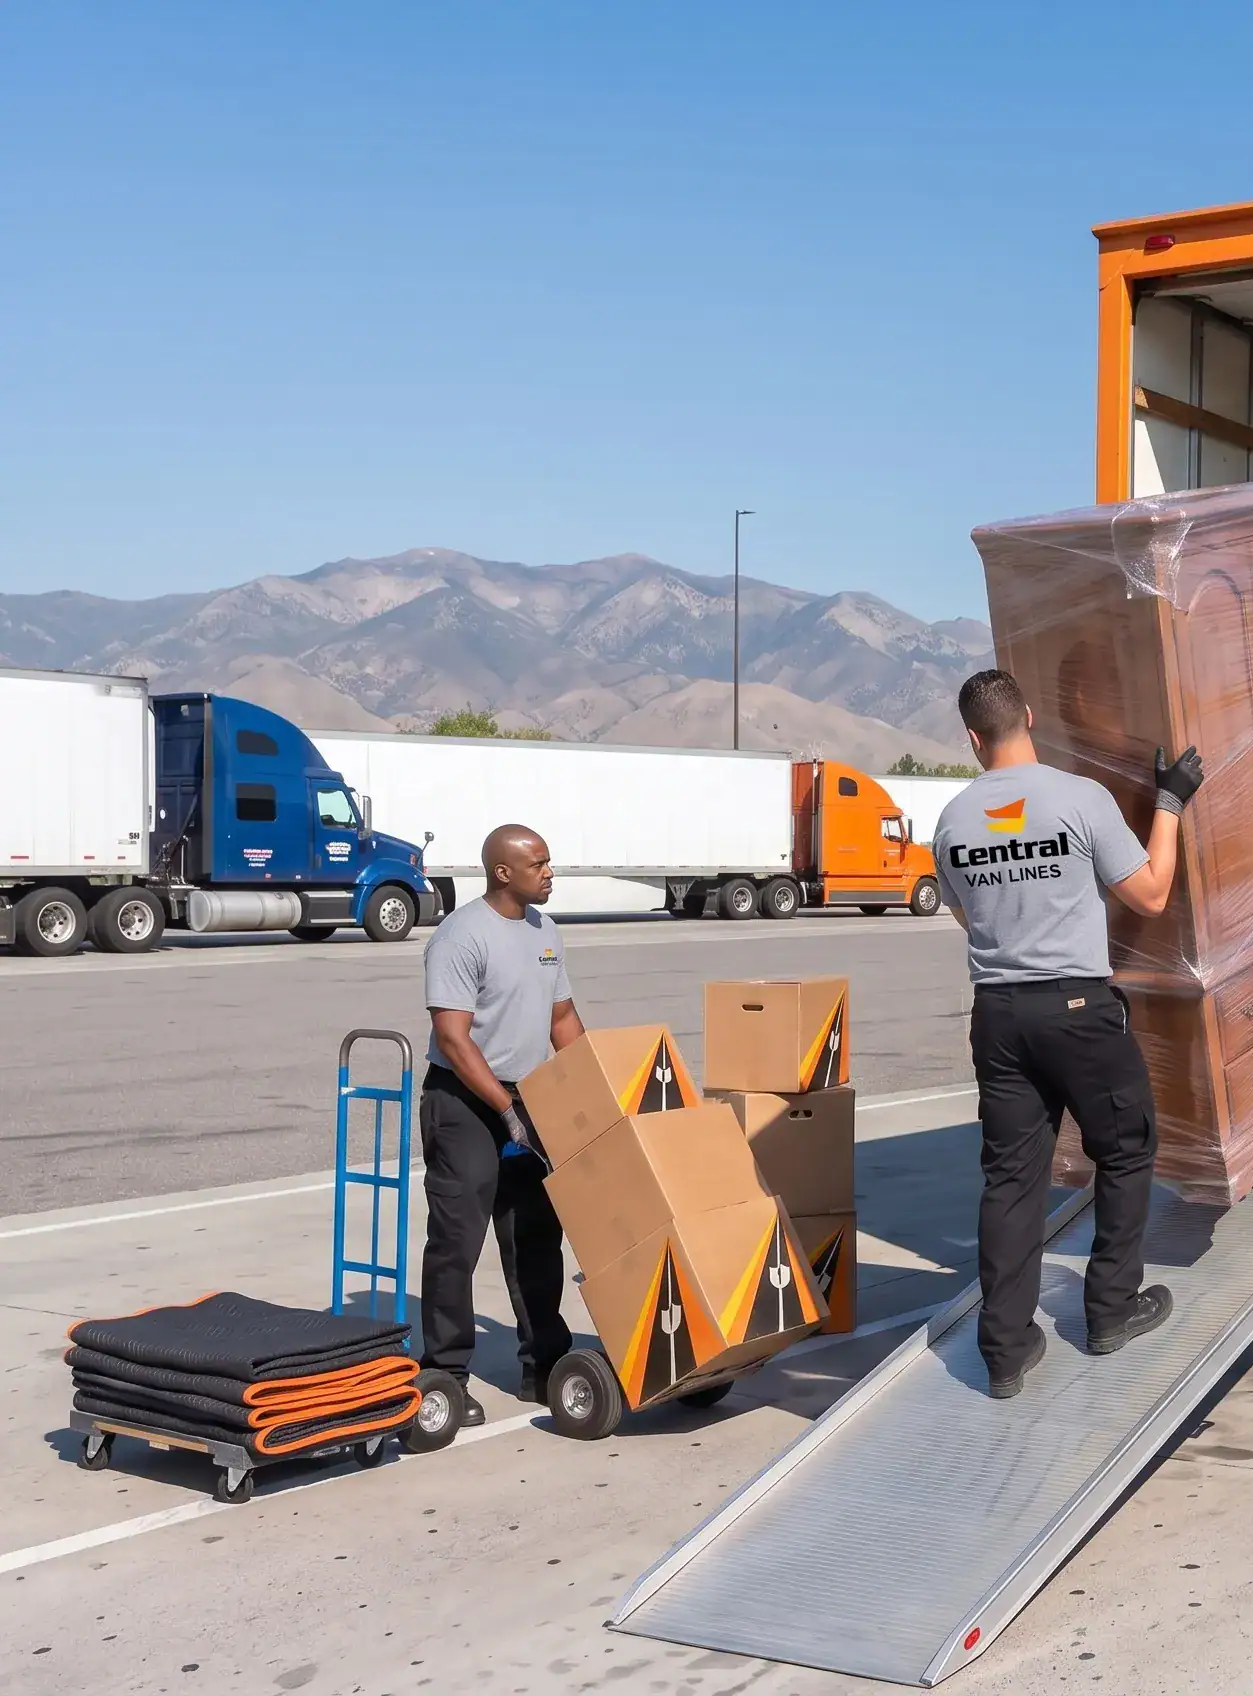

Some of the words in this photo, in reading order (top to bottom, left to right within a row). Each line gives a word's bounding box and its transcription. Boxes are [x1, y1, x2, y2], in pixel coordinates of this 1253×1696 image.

[949, 831, 1070, 869] Central
[965, 872, 1002, 888] VAN
[1008, 864, 1062, 883] LINES
